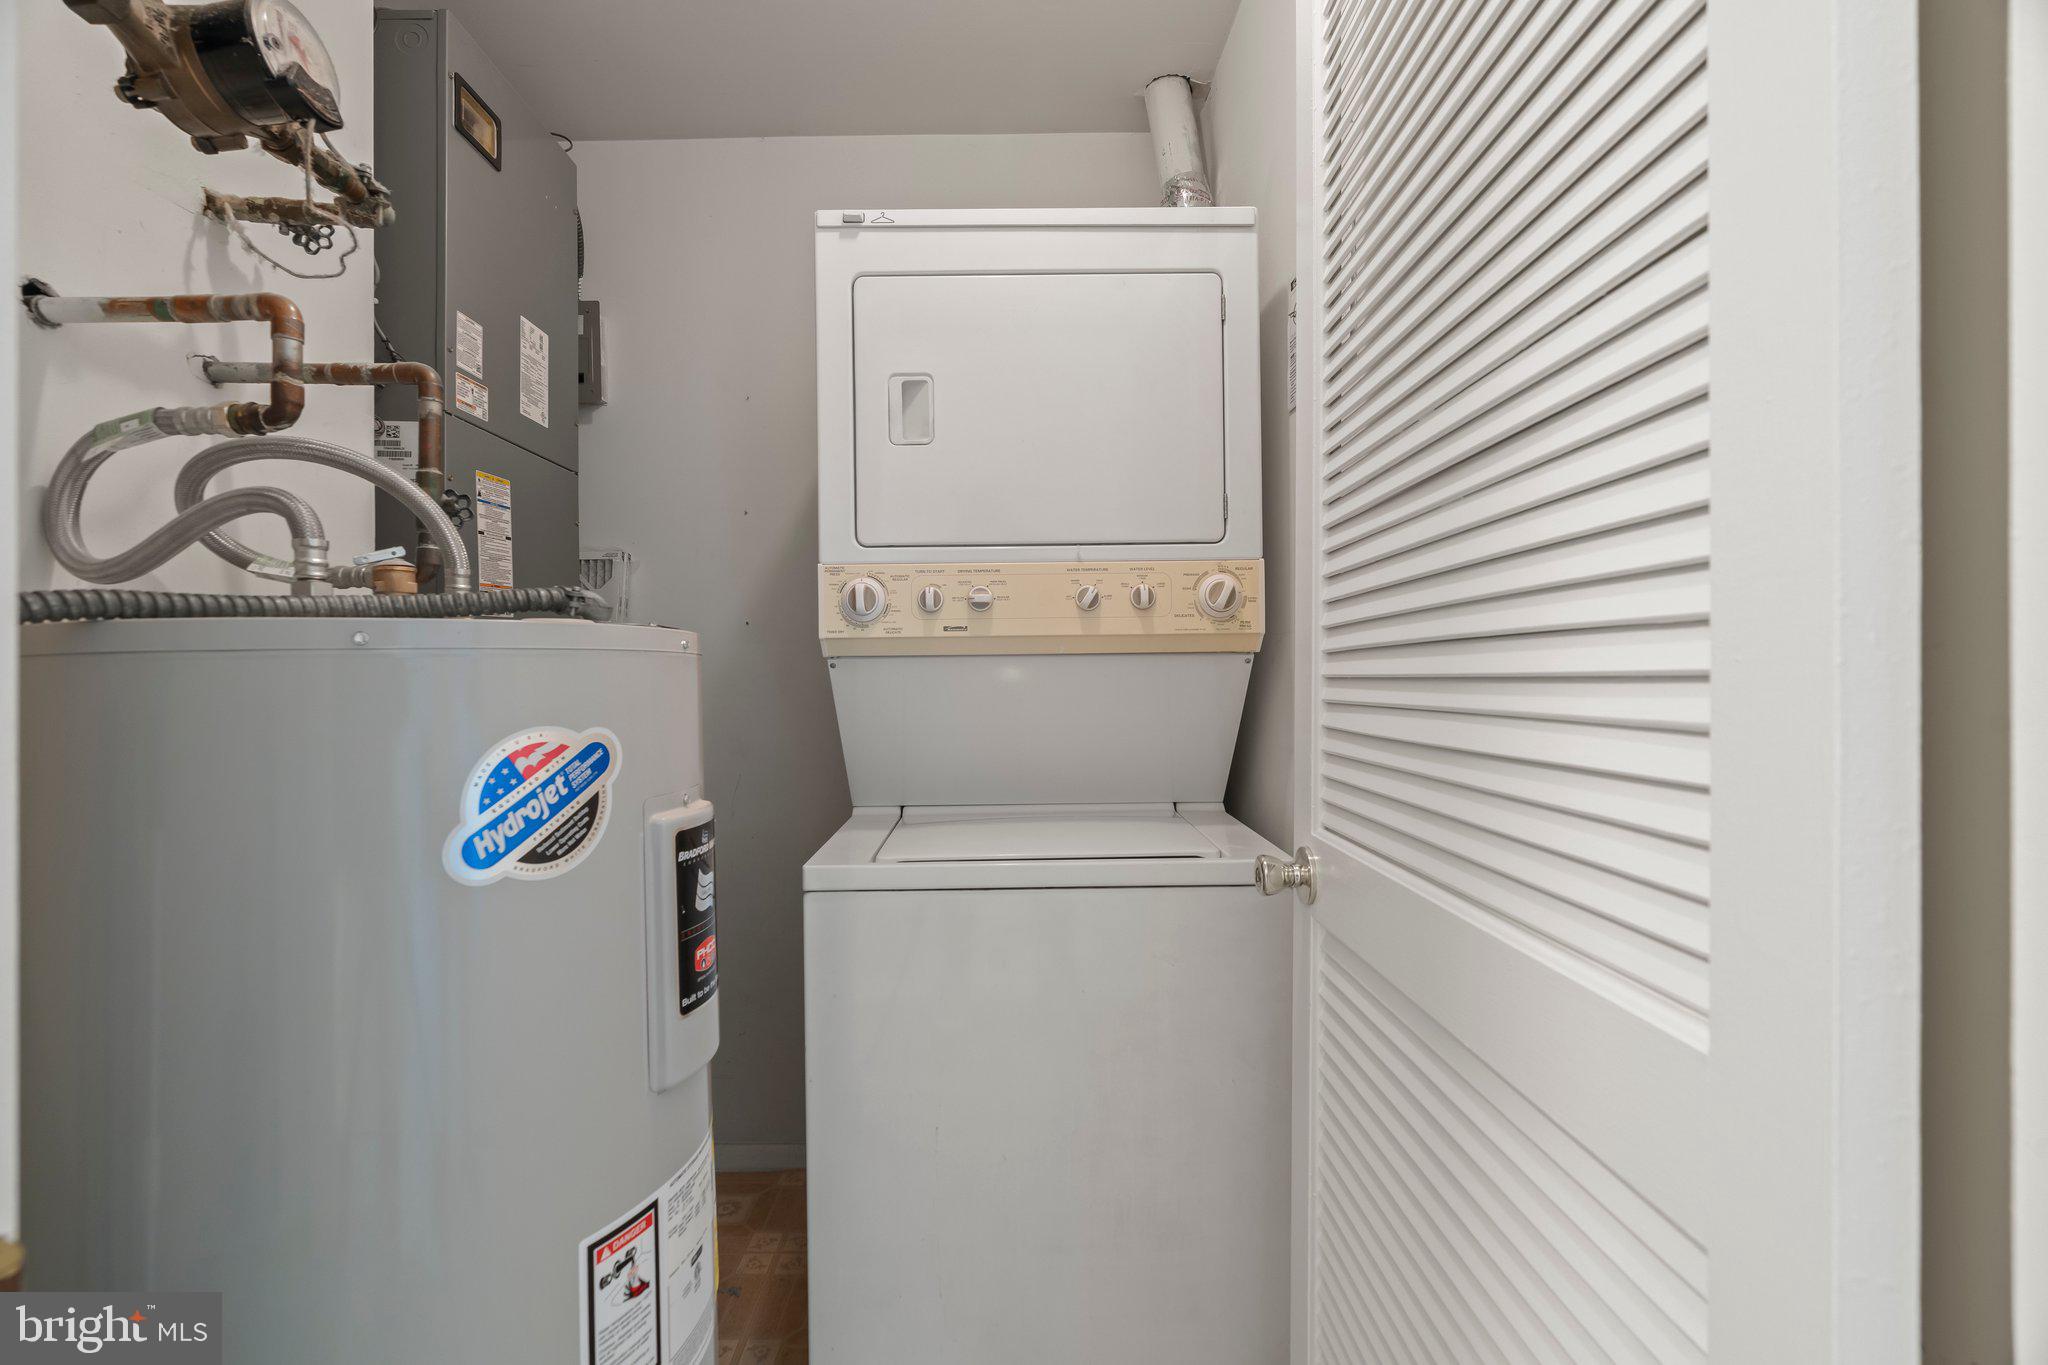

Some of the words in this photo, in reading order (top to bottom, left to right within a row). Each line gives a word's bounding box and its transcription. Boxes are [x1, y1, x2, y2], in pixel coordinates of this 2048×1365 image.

[568, 747, 604, 782] PERFORMANCE
[491, 776, 541, 814] EQUIPPED
[544, 755, 566, 773] WITH
[472, 773, 569, 860] Hydrojet
[533, 800, 582, 842] FEATURING
[513, 863, 560, 873] BRADFORD
[564, 844, 586, 864] WHITE
[678, 843, 709, 862] BRADFORD
[681, 994, 697, 1008] Built
[612, 1220, 647, 1251] DANGER
